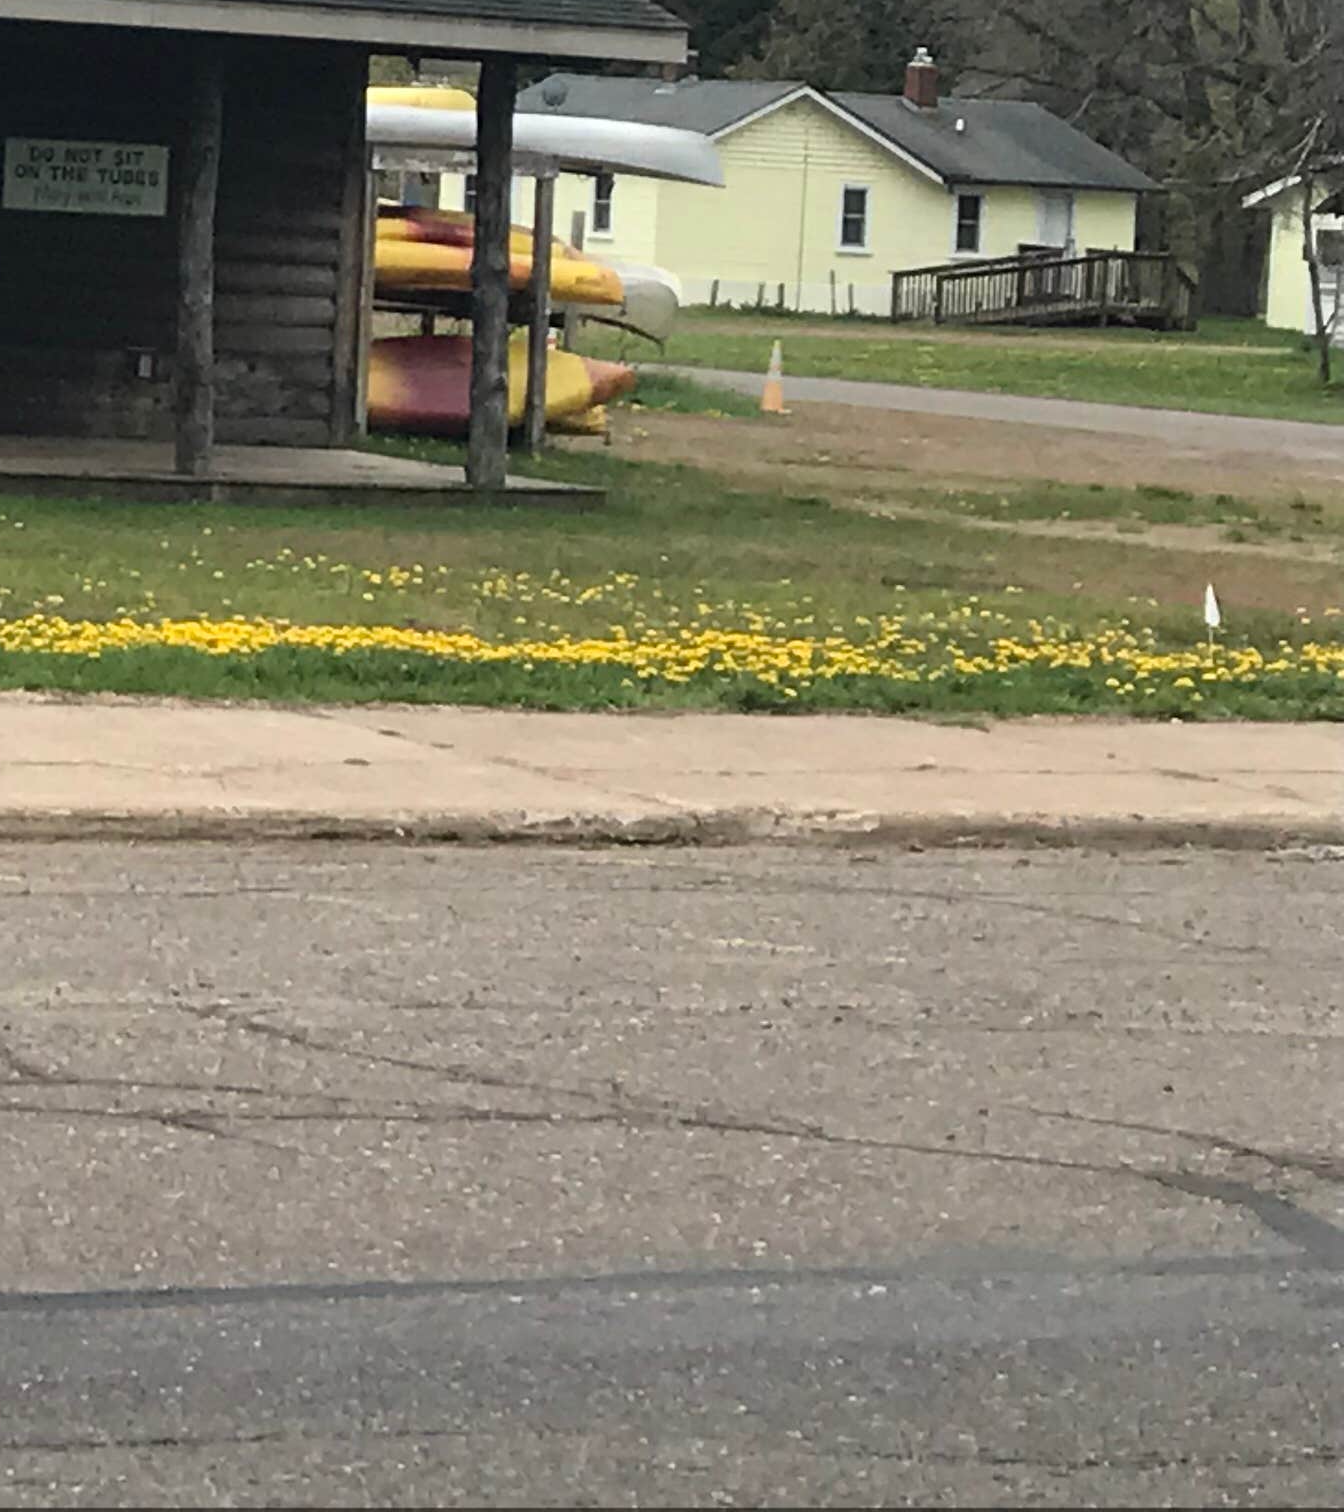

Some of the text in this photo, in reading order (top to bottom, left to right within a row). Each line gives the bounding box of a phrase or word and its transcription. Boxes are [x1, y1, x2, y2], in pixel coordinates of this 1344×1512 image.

[29, 146, 145, 167] DO NOT SIT
[50, 166, 89, 183] THE
